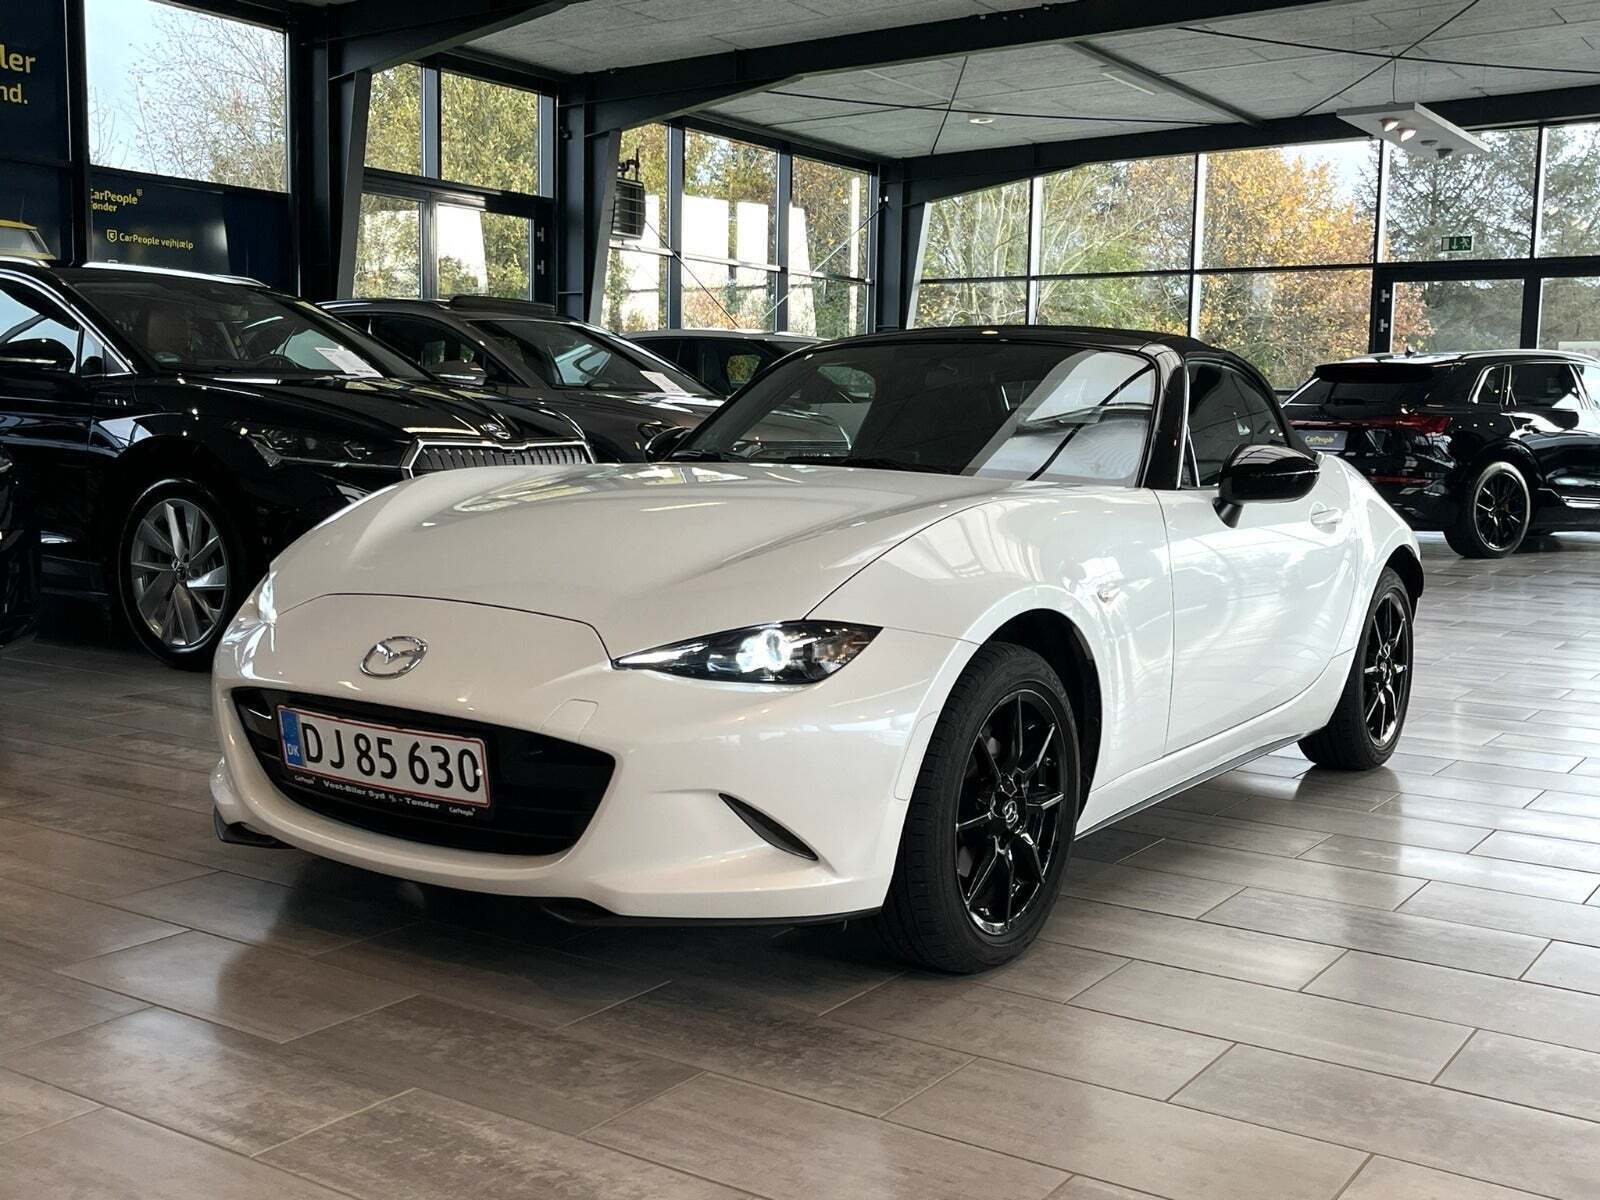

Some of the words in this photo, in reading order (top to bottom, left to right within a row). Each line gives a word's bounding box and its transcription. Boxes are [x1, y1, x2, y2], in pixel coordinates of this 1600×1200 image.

[91, 202, 118, 212] ønder
[119, 233, 160, 246] CarPeople
[161, 239, 194, 250] vejhjælp
[287, 743, 300, 757] DK
[301, 722, 345, 769] DJ
[354, 733, 397, 779] 85
[408, 741, 480, 793] 630
